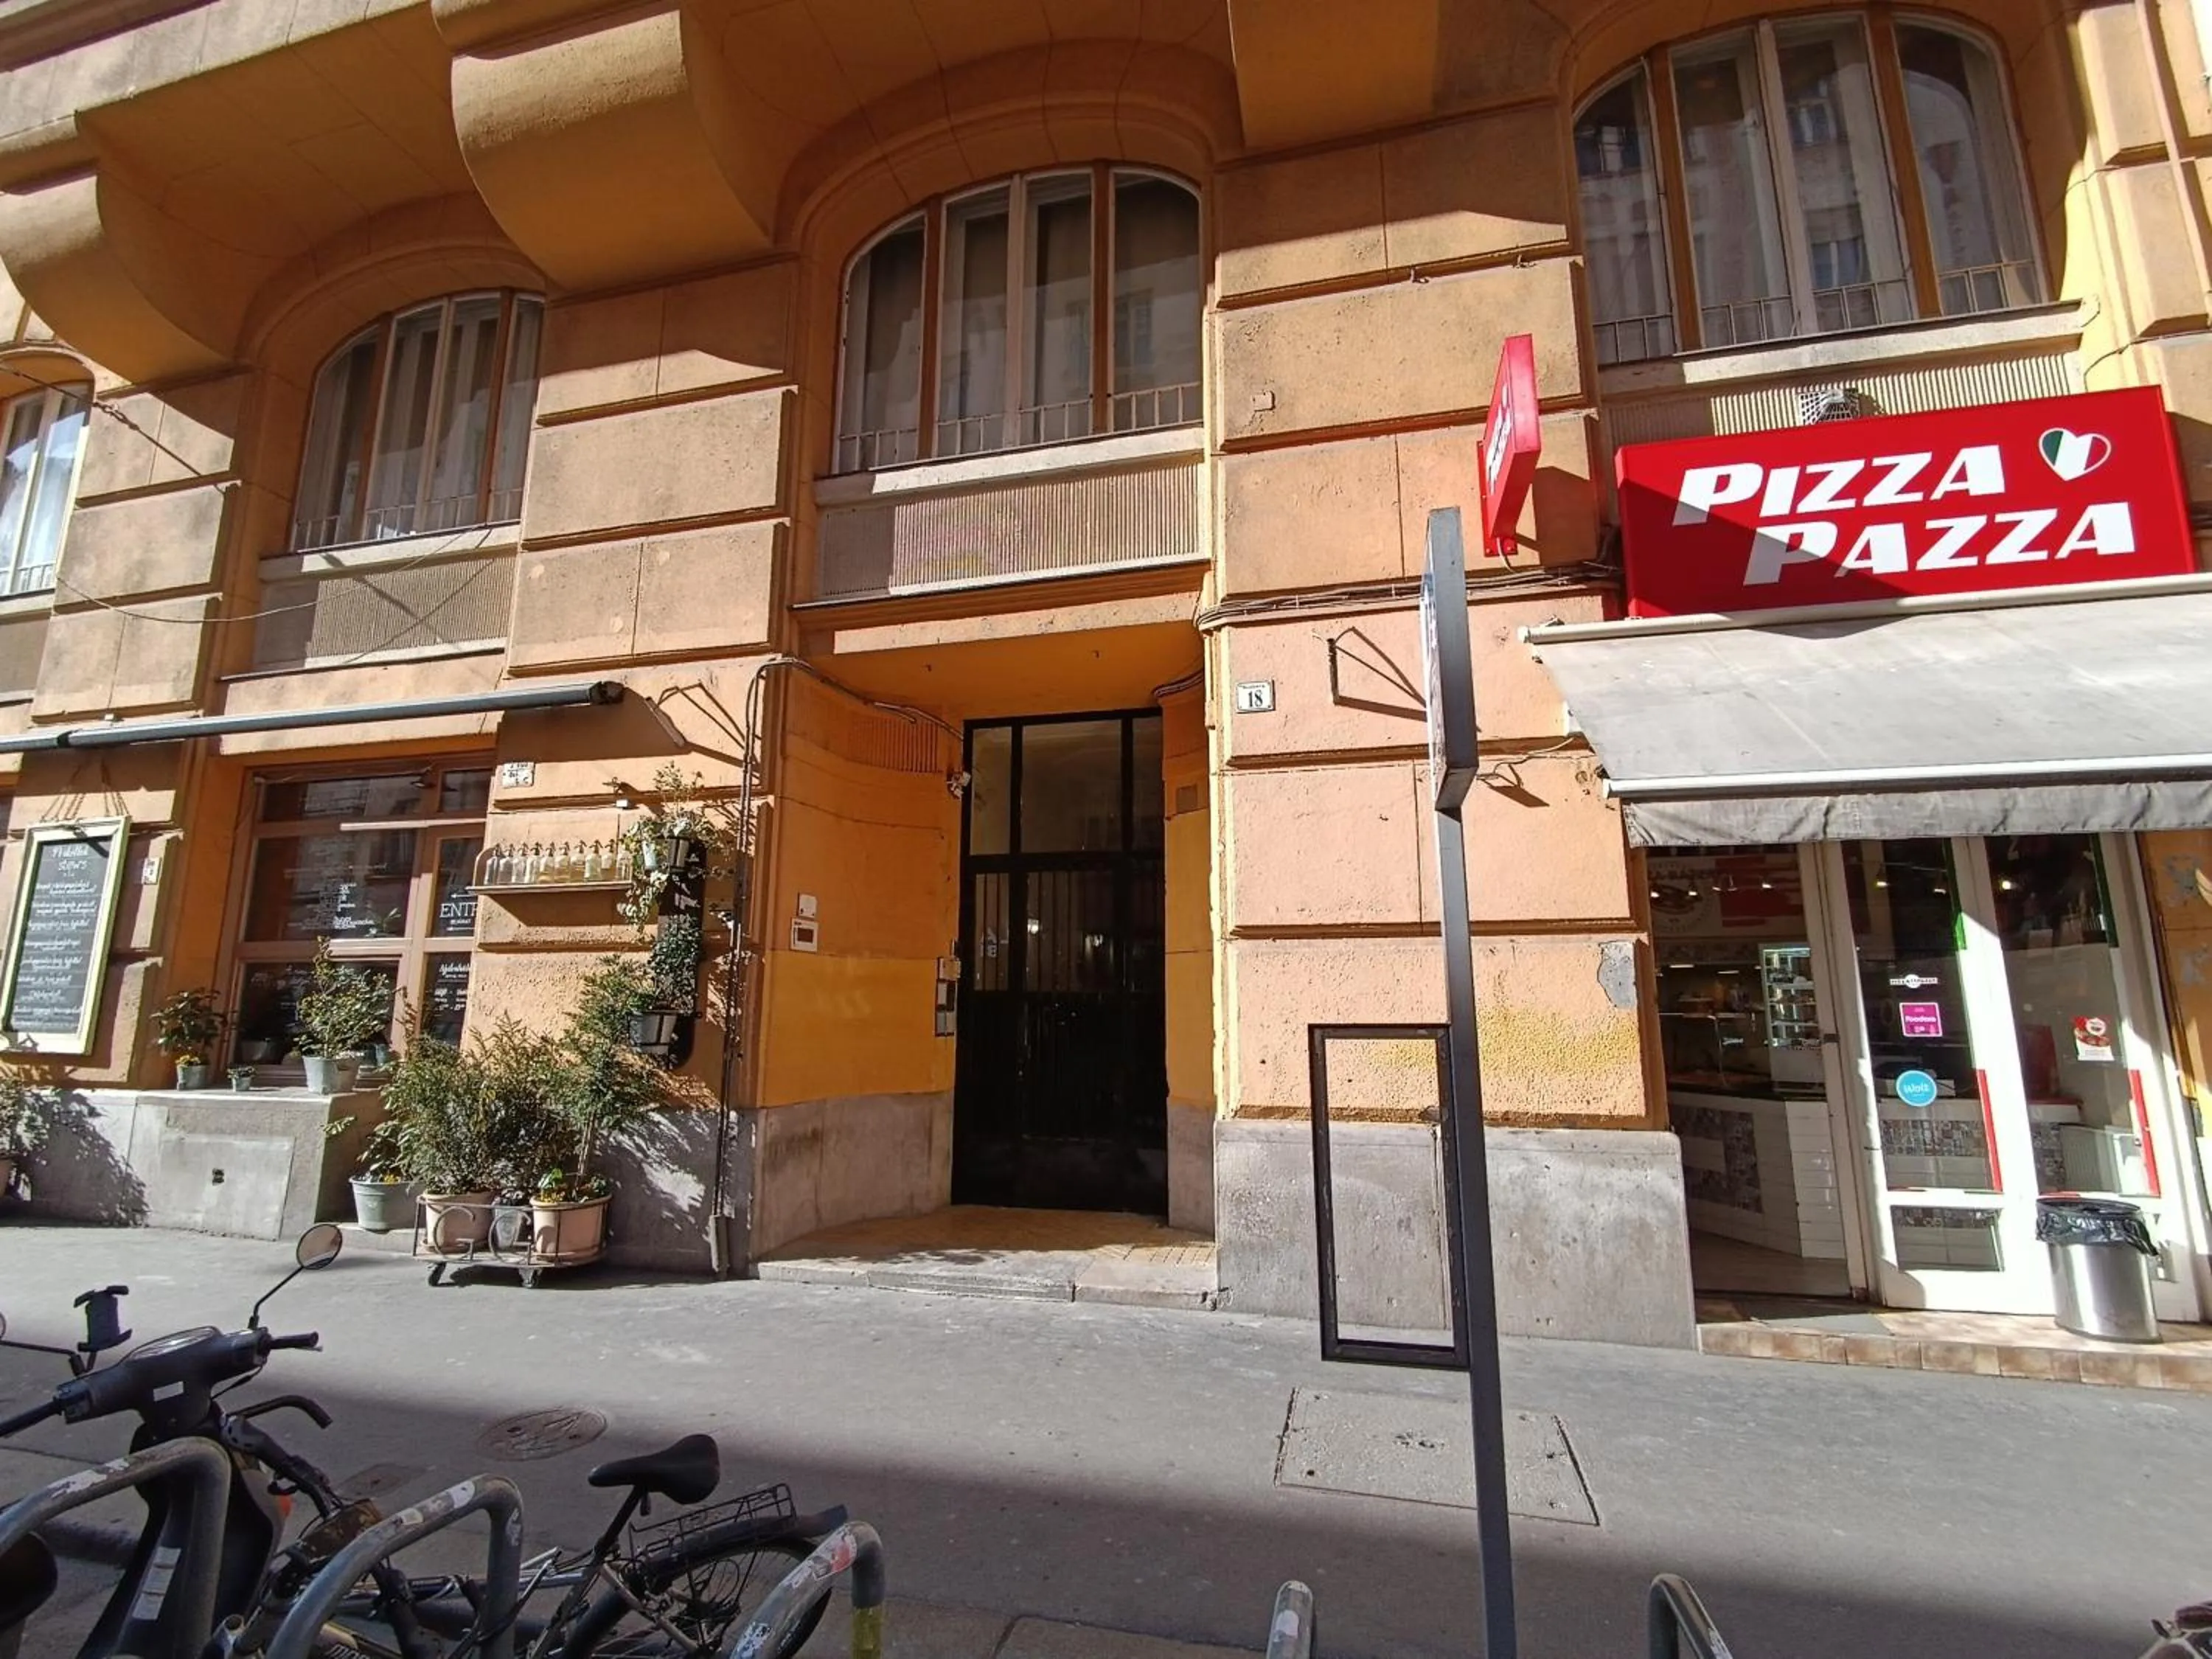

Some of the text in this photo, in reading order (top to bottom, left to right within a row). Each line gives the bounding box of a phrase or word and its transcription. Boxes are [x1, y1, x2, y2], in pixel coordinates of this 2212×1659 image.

[1672, 445, 2006, 526] PIZZA
[1743, 501, 2136, 586] PAZZA
[1248, 689, 1262, 707] 18
[1903, 1082, 1929, 1093] Wolt
